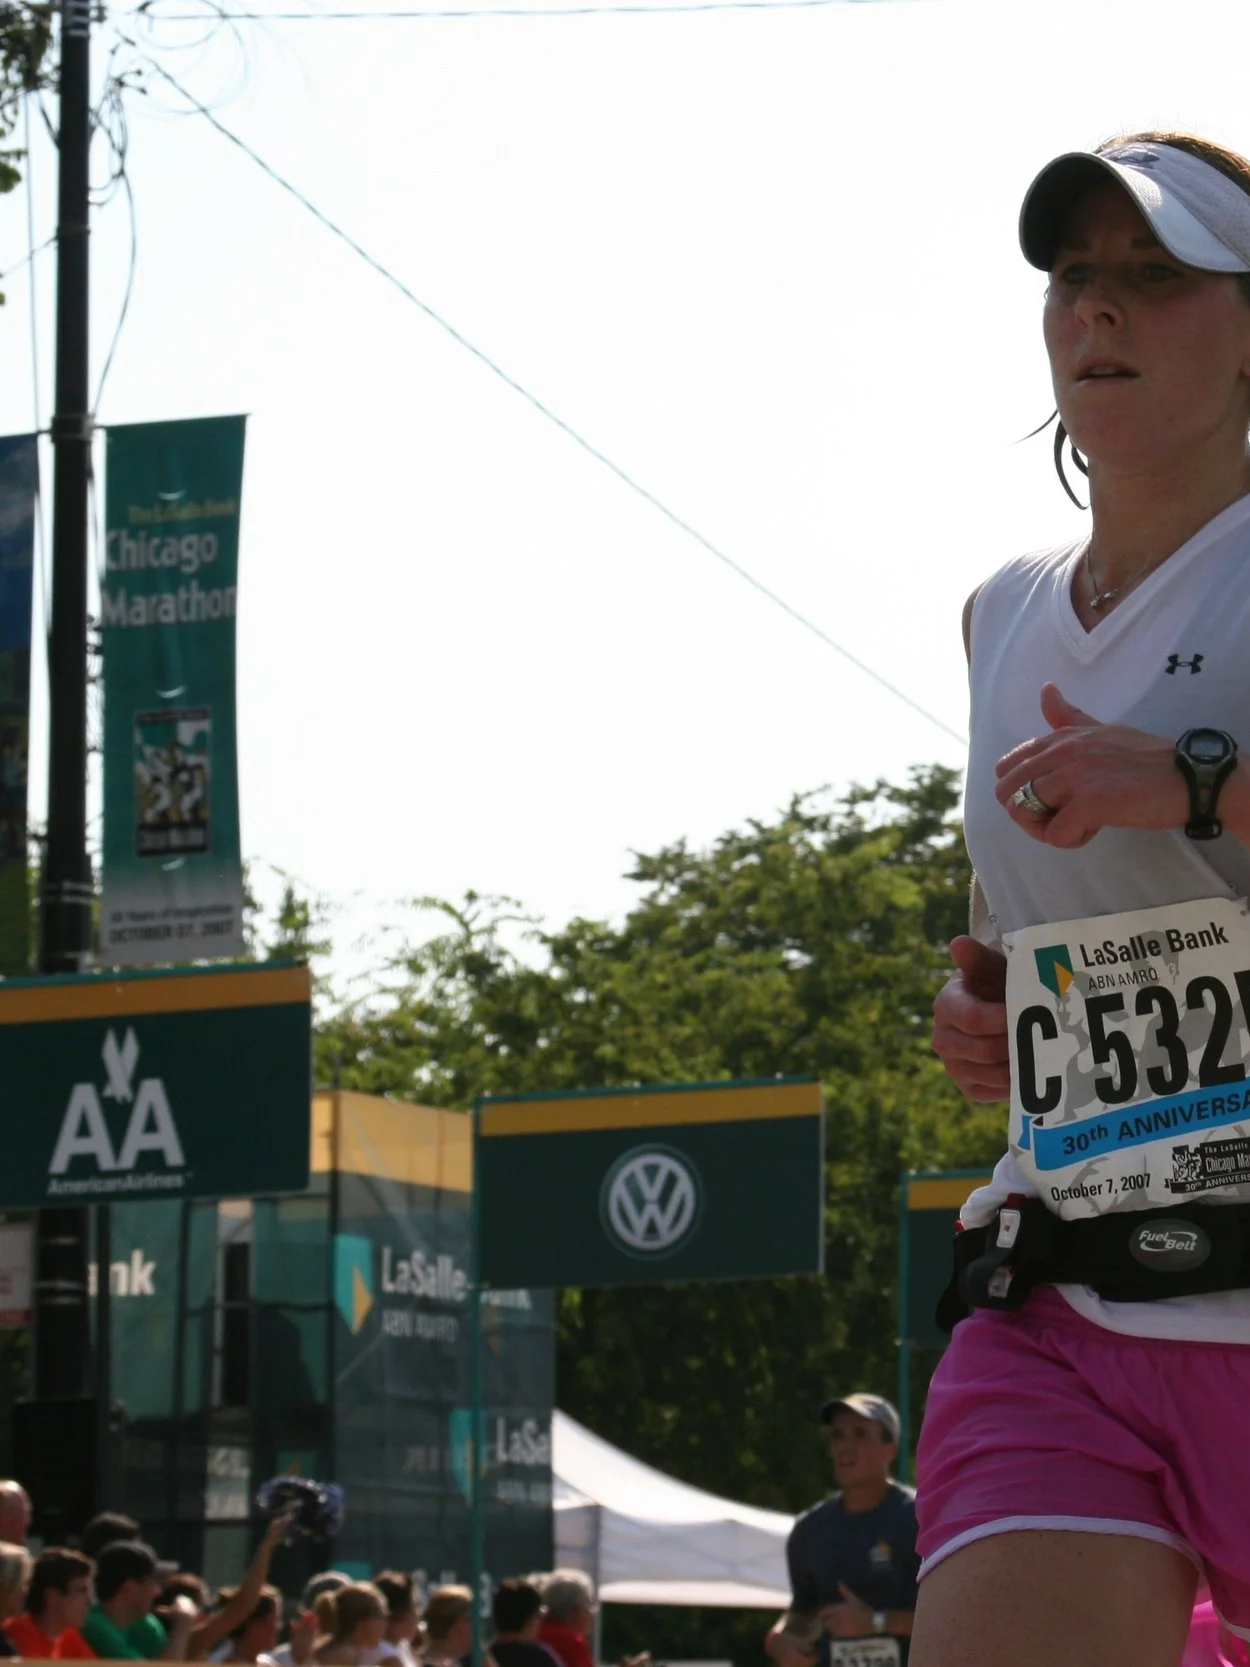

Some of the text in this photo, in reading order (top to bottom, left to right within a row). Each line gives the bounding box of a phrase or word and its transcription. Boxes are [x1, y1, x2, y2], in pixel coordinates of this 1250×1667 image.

[106, 529, 218, 574] Chicago
[101, 580, 237, 626] Marathon
[1079, 921, 1229, 968] LaSalle Bank
[1088, 966, 1159, 991] ABN AMRO
[1016, 1004, 1062, 1115] C
[48, 1077, 187, 1175] AA
[1062, 1125, 1109, 1156] 30th
[1205, 1146, 1217, 1154] The
[1221, 1142, 1248, 1153] LaSalle
[1205, 1156, 1236, 1173] Chicago
[1050, 1173, 1151, 1202] October 7, 2007
[1139, 1230, 1169, 1242] Fuel
[1165, 1239, 1197, 1251] Belt
[381, 1245, 467, 1302] LaSalle
